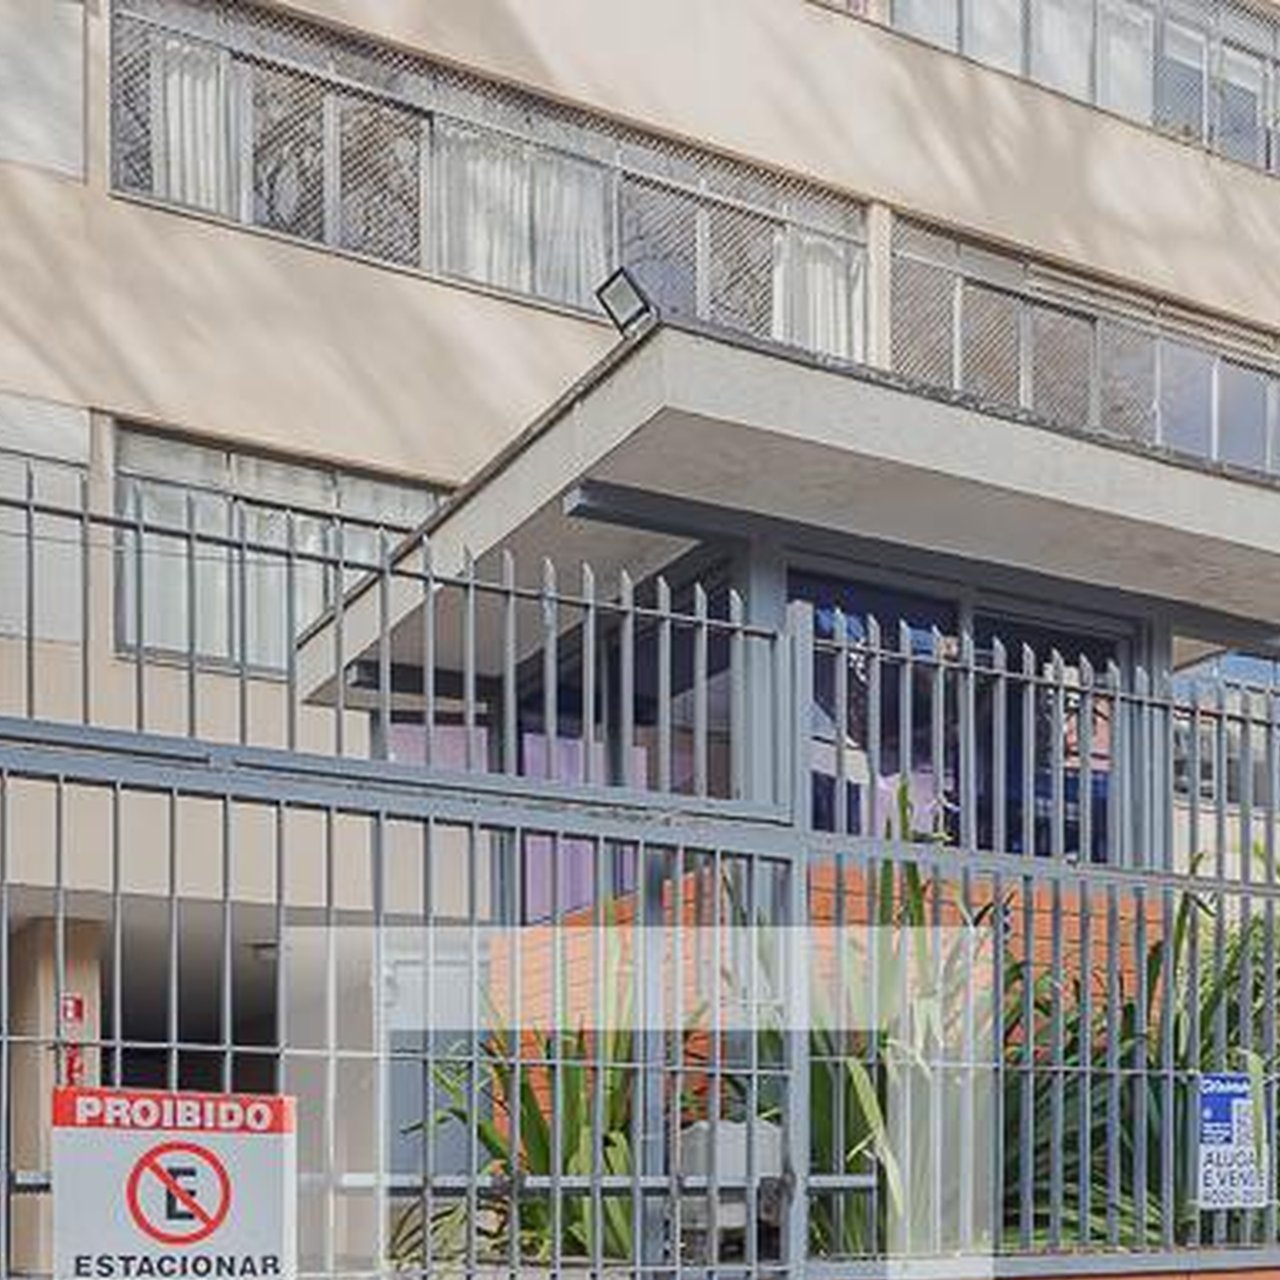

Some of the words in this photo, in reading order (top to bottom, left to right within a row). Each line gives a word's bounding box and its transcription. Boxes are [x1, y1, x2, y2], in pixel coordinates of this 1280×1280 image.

[74, 1096, 272, 1129] PROIBIDO
[165, 1167, 197, 1221] E
[74, 1255, 281, 1278] ESTACIONAR
